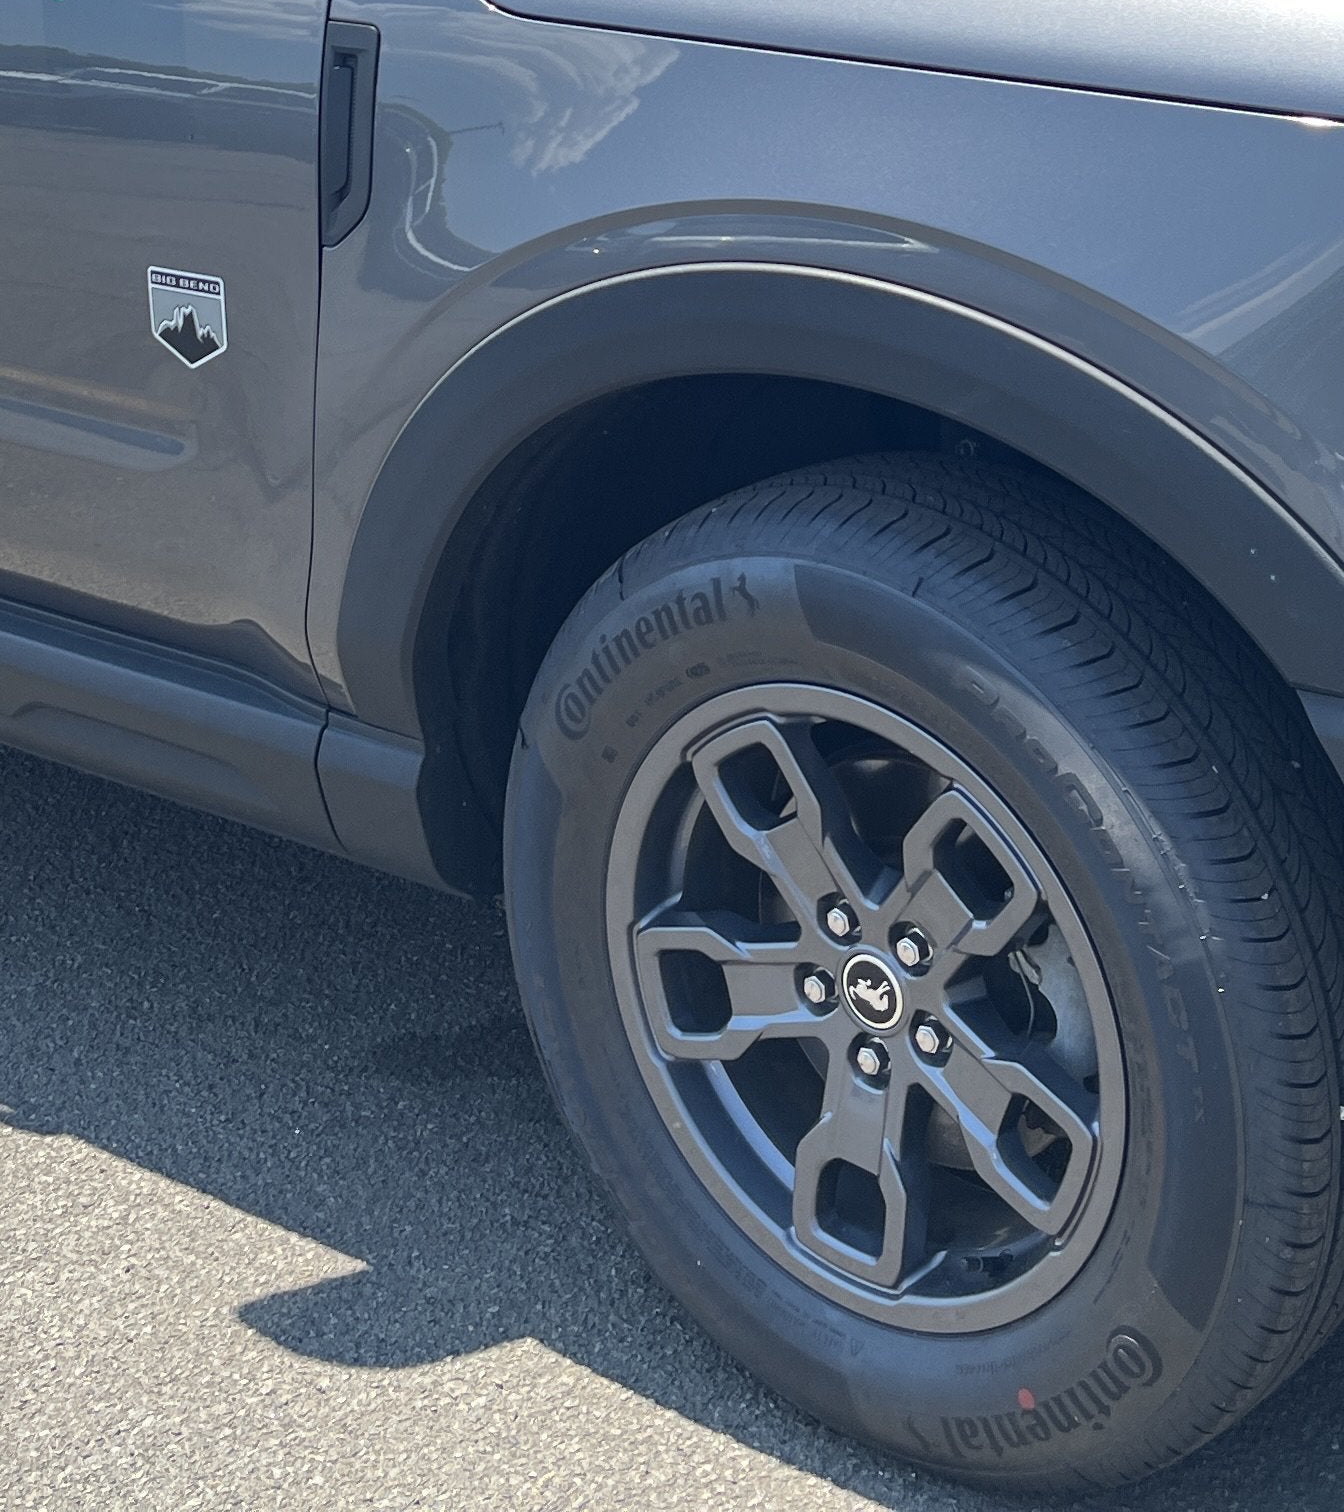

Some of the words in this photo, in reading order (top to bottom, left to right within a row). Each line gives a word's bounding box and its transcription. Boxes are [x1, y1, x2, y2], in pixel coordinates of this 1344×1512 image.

[152, 273, 176, 286] BIG
[179, 278, 220, 293] BEND
[555, 575, 728, 740] Continental
[940, 1324, 1163, 1460] Continental
